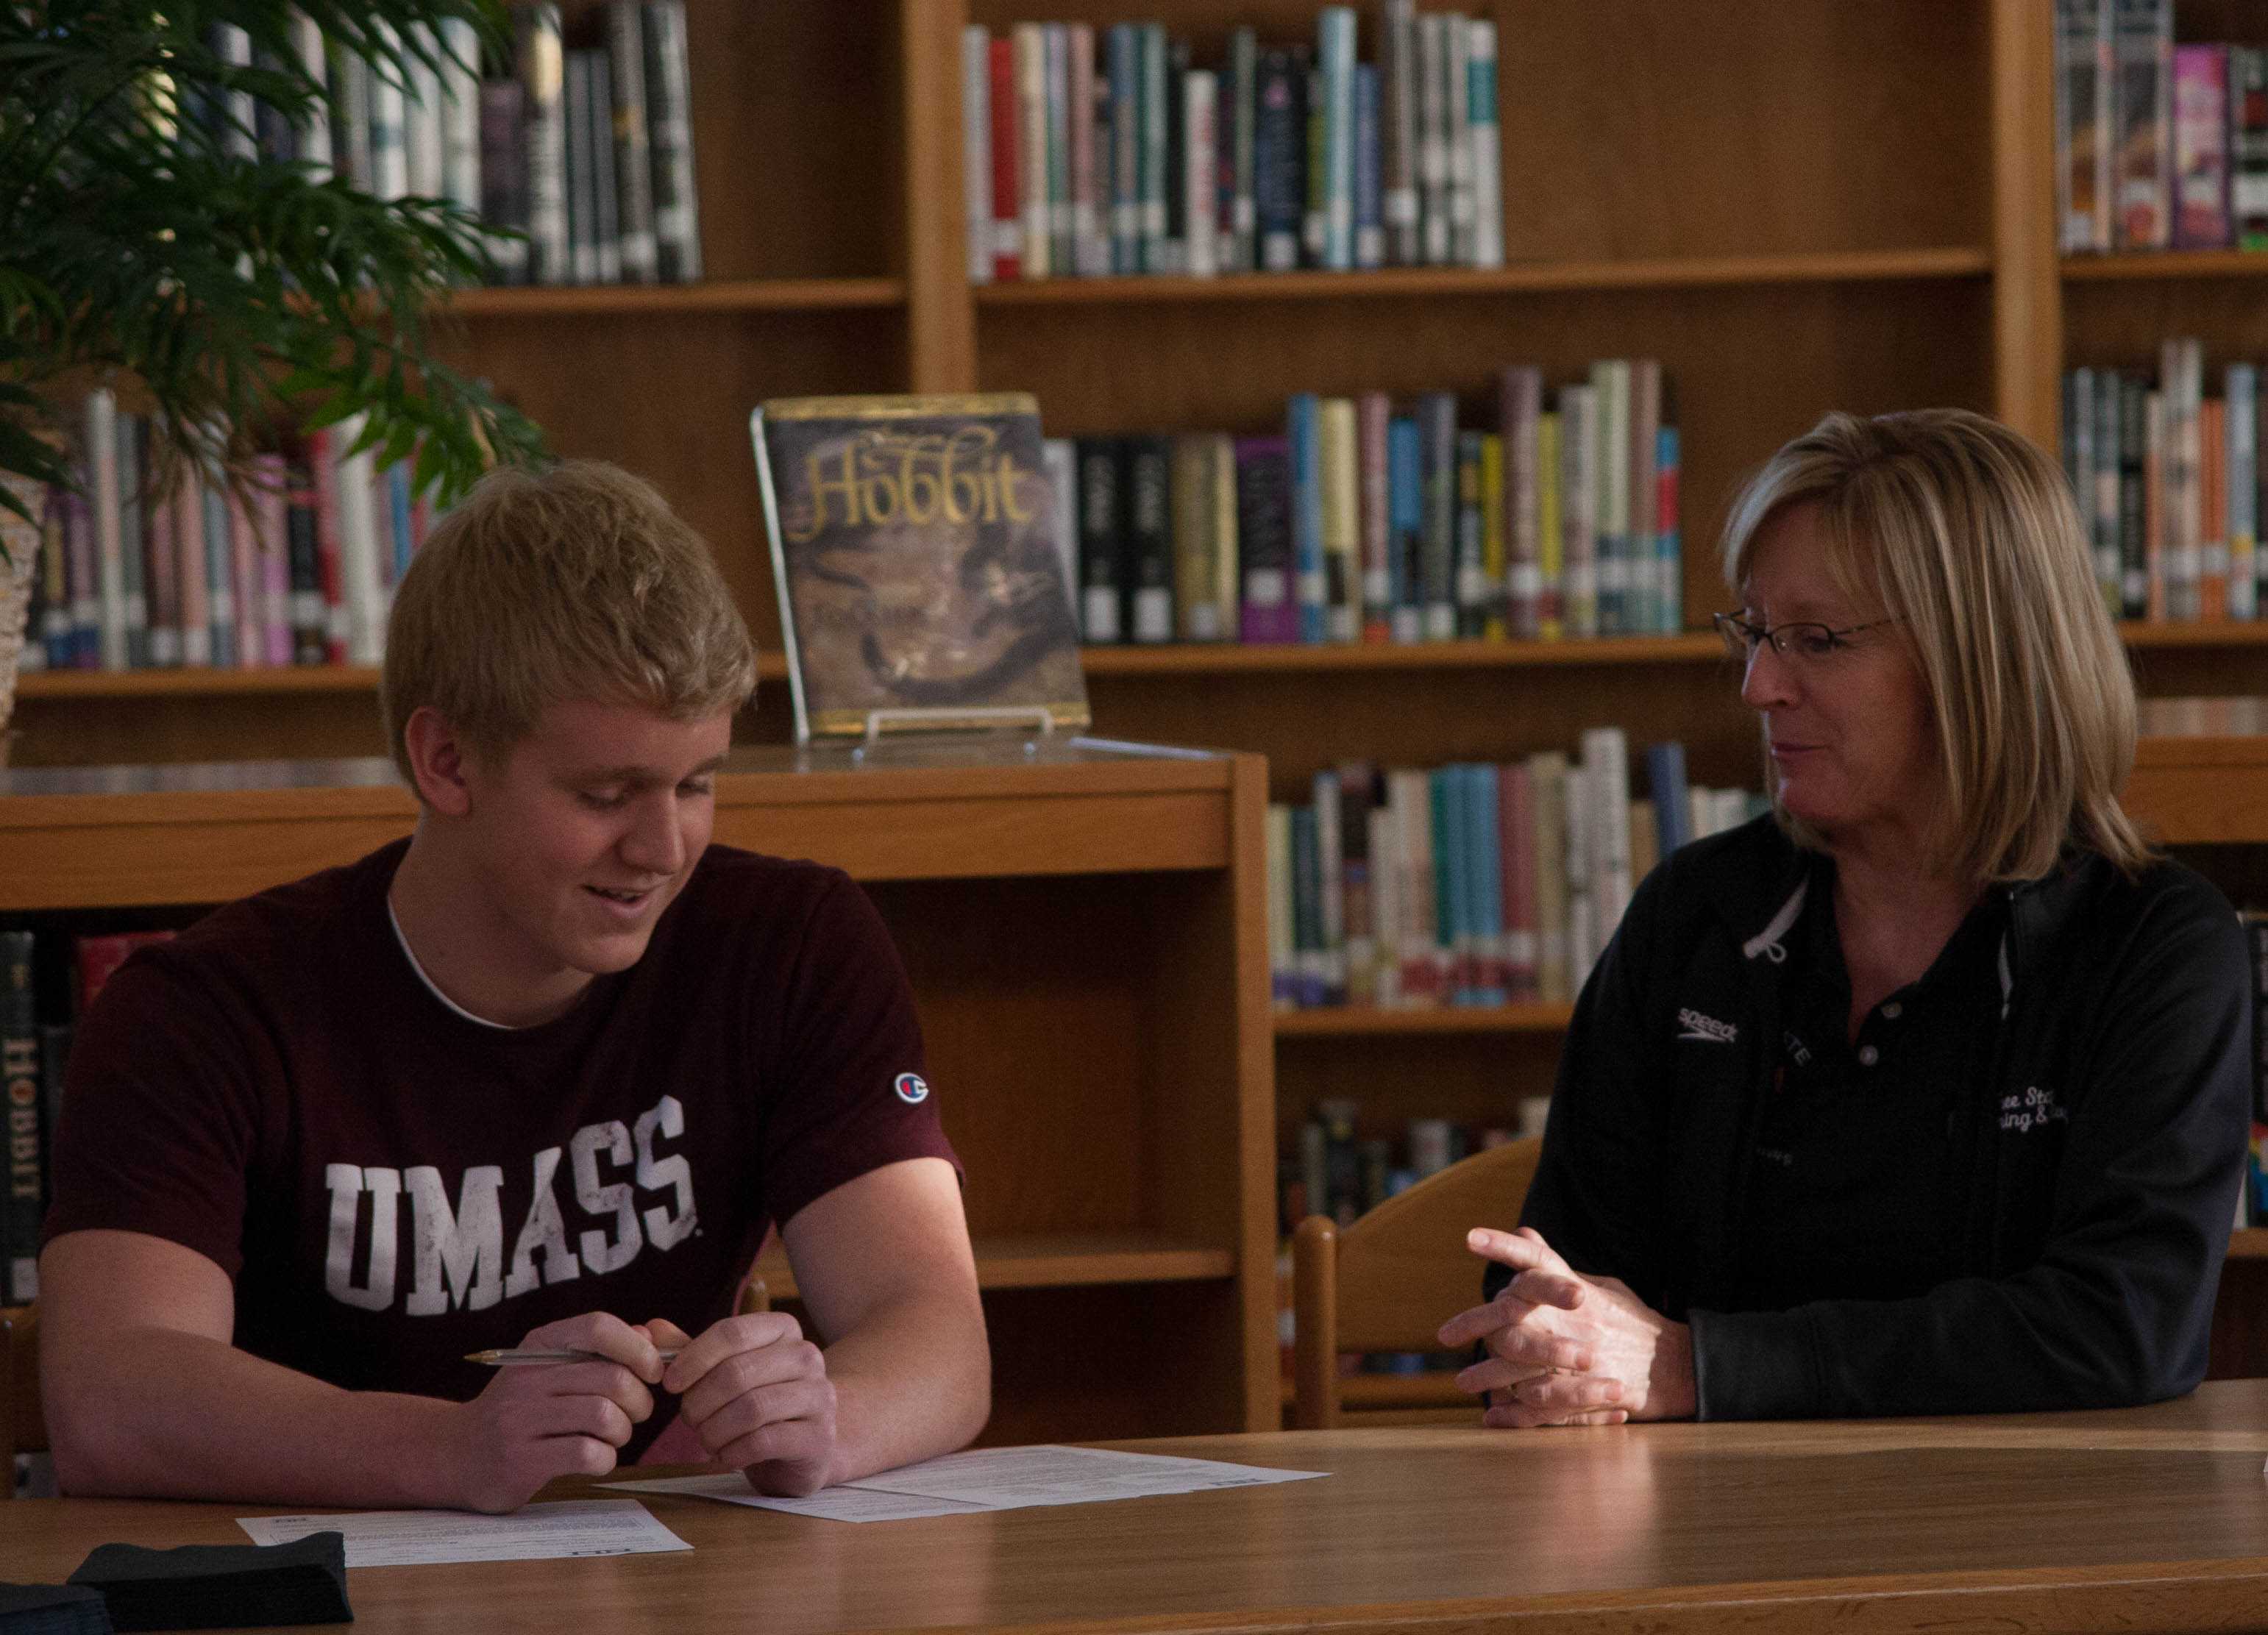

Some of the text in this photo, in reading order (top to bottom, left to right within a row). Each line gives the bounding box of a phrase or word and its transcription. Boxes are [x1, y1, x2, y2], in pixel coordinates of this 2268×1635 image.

[786, 426, 1036, 543] Hobbit
[2035, 1105, 2048, 1125] &
[324, 1094, 699, 1317] UMASS
